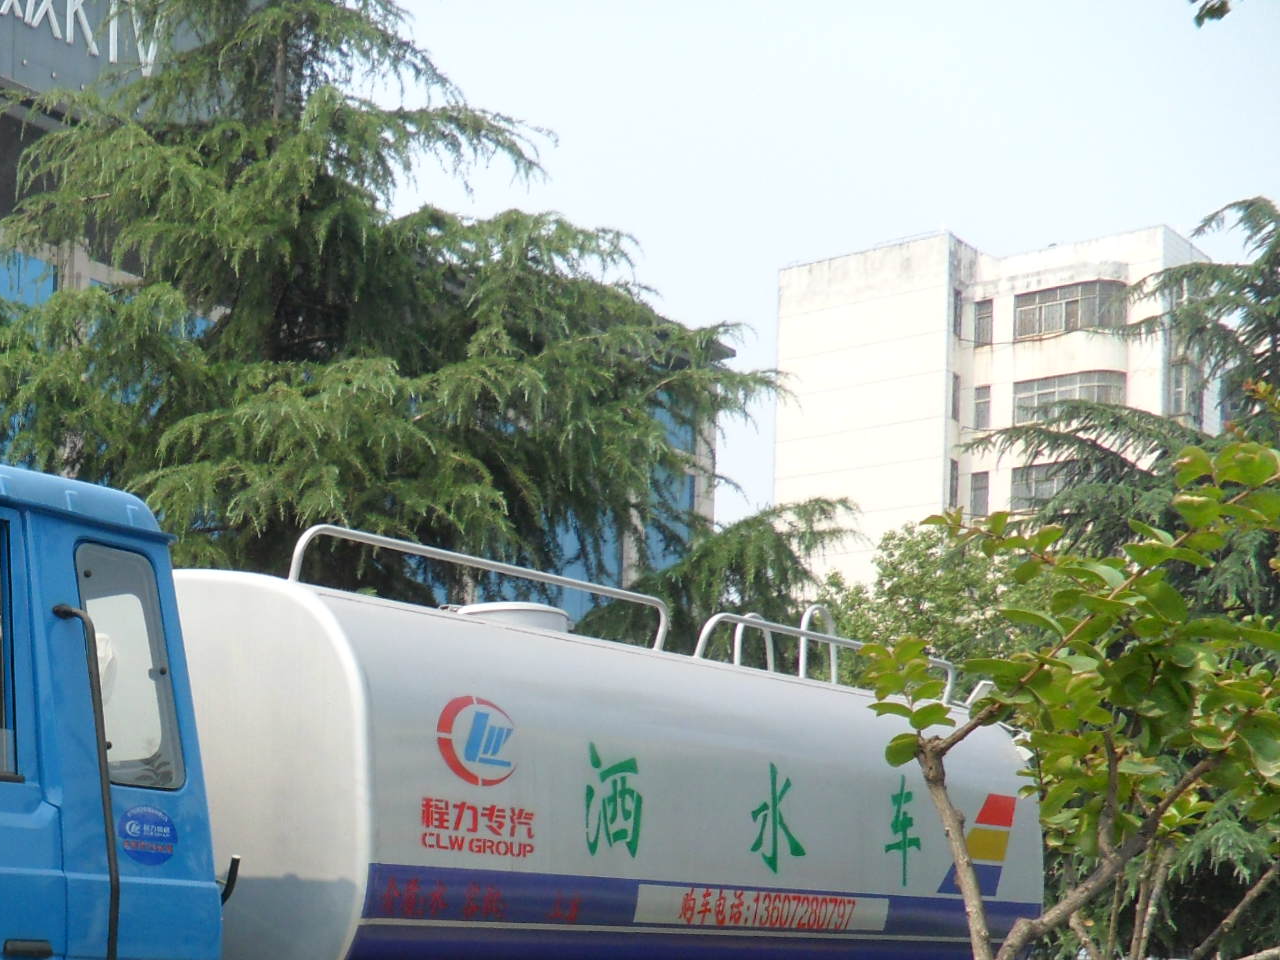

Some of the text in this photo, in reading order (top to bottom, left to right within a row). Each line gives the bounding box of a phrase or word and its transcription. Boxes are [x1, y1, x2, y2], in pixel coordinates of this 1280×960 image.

[421, 797, 535, 840] 程力专汽
[585, 742, 921, 887] 洒水车
[421, 832, 535, 858] CLW GROUP
